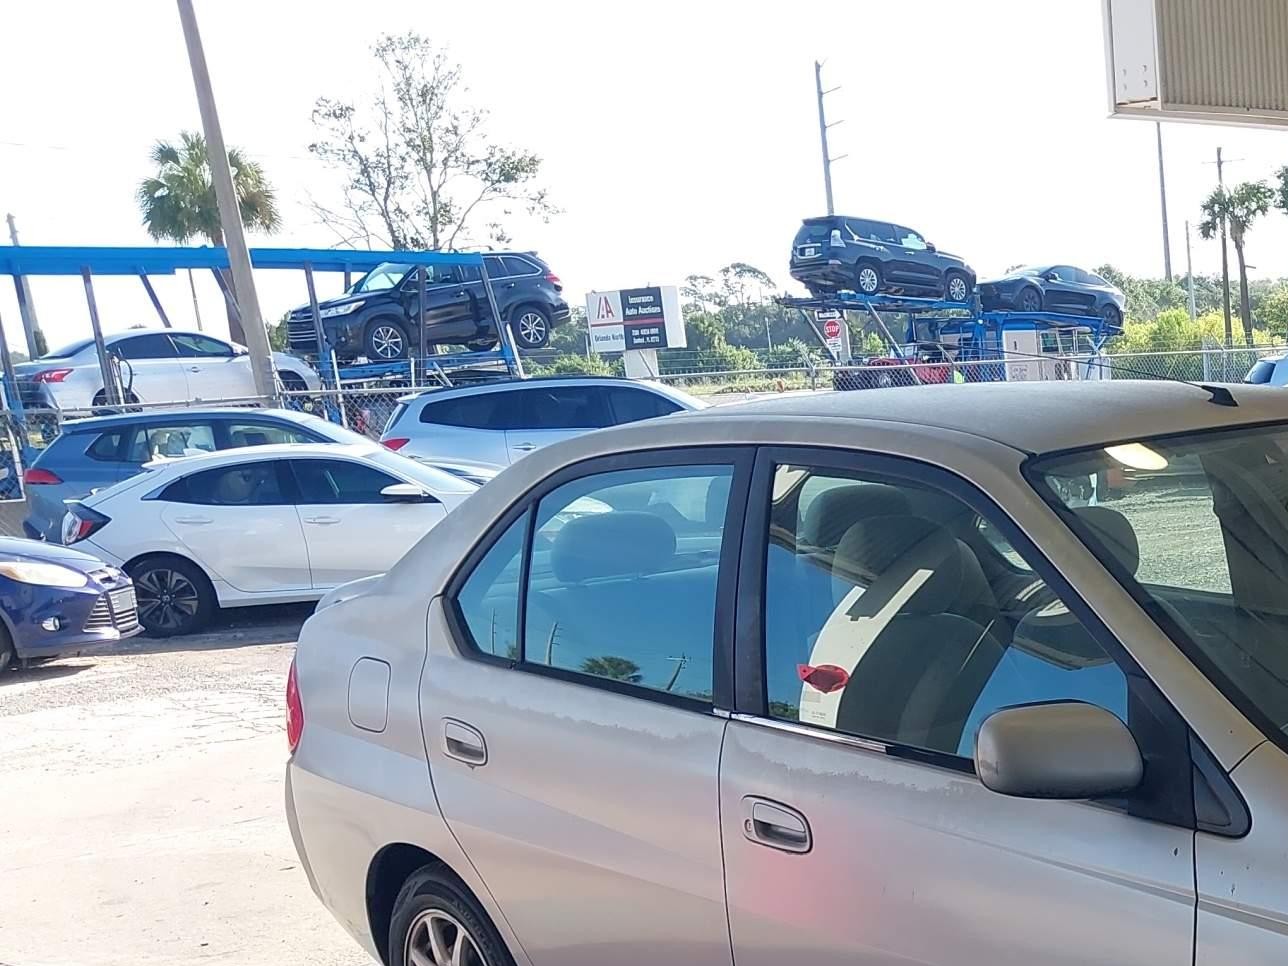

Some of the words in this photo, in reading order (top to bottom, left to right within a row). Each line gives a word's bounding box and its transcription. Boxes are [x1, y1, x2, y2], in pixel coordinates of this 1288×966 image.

[628, 295, 654, 304] Insurance
[625, 307, 638, 315] Auto
[638, 305, 661, 314] Auctions
[825, 325, 839, 333] STOP
